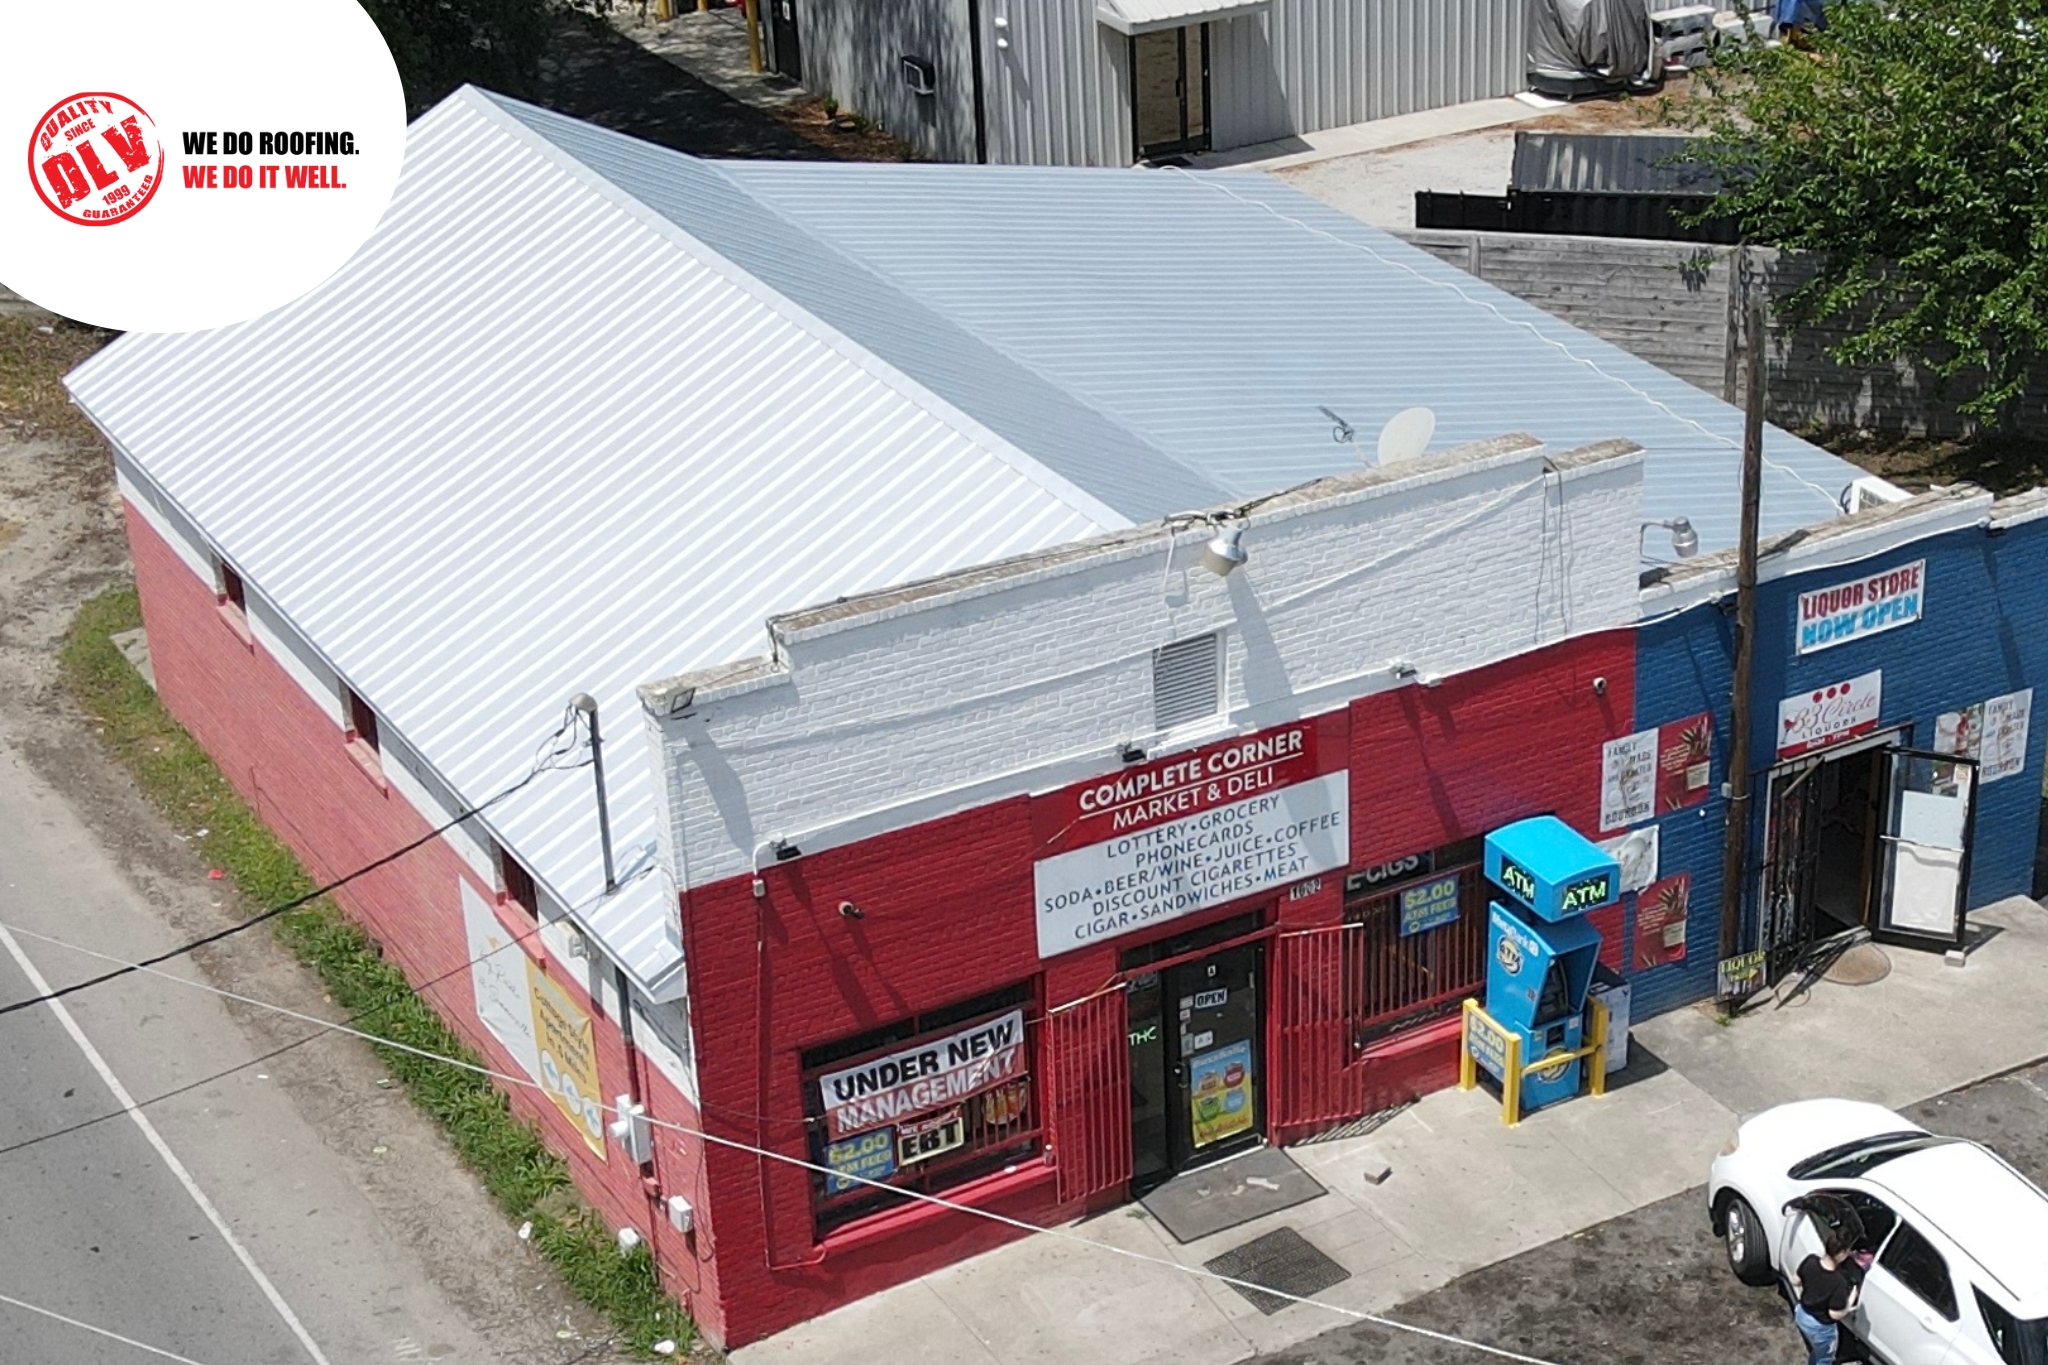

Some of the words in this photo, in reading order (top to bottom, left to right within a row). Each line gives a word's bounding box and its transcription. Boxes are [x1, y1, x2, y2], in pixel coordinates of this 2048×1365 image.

[1802, 585, 1863, 620] LIQUOR
[1867, 566, 1919, 602] STORE
[1802, 613, 1855, 647] NOW
[1861, 594, 1919, 630] OPEN
[1079, 758, 1202, 811] COMPLETE
[1207, 730, 1303, 773] CORNER
[1113, 788, 1201, 830] MARKET
[1207, 784, 1221, 802] &
[1228, 766, 1273, 797] DELI
[1107, 823, 1185, 858] LOTTERY
[1199, 794, 1280, 830] GROCERY
[1136, 820, 1254, 867] PHONECARDS
[1045, 887, 1093, 914] SODA
[1104, 853, 1203, 896] BEER/WINE
[1214, 836, 1263, 863] JUICE
[1274, 811, 1341, 843] COFFEE
[1093, 876, 1183, 917] DISCOUNT
[1190, 842, 1296, 887] CIGARETTES
[1501, 866, 1536, 900] ATM
[1075, 912, 1129, 940] CIGAR
[1140, 877, 1253, 921] SANDWICHES
[1264, 856, 1309, 881] MEAT
[1405, 880, 1455, 911] $2.00
[1562, 881, 1606, 911] ATM
[1196, 990, 1226, 1007] OPEN
[833, 1050, 939, 1101] UNDER
[948, 1019, 1014, 1061] NEW
[1128, 1026, 1157, 1047] THC
[837, 1048, 1016, 1132] MANAGEMENT
[902, 1120, 958, 1159] EBT
